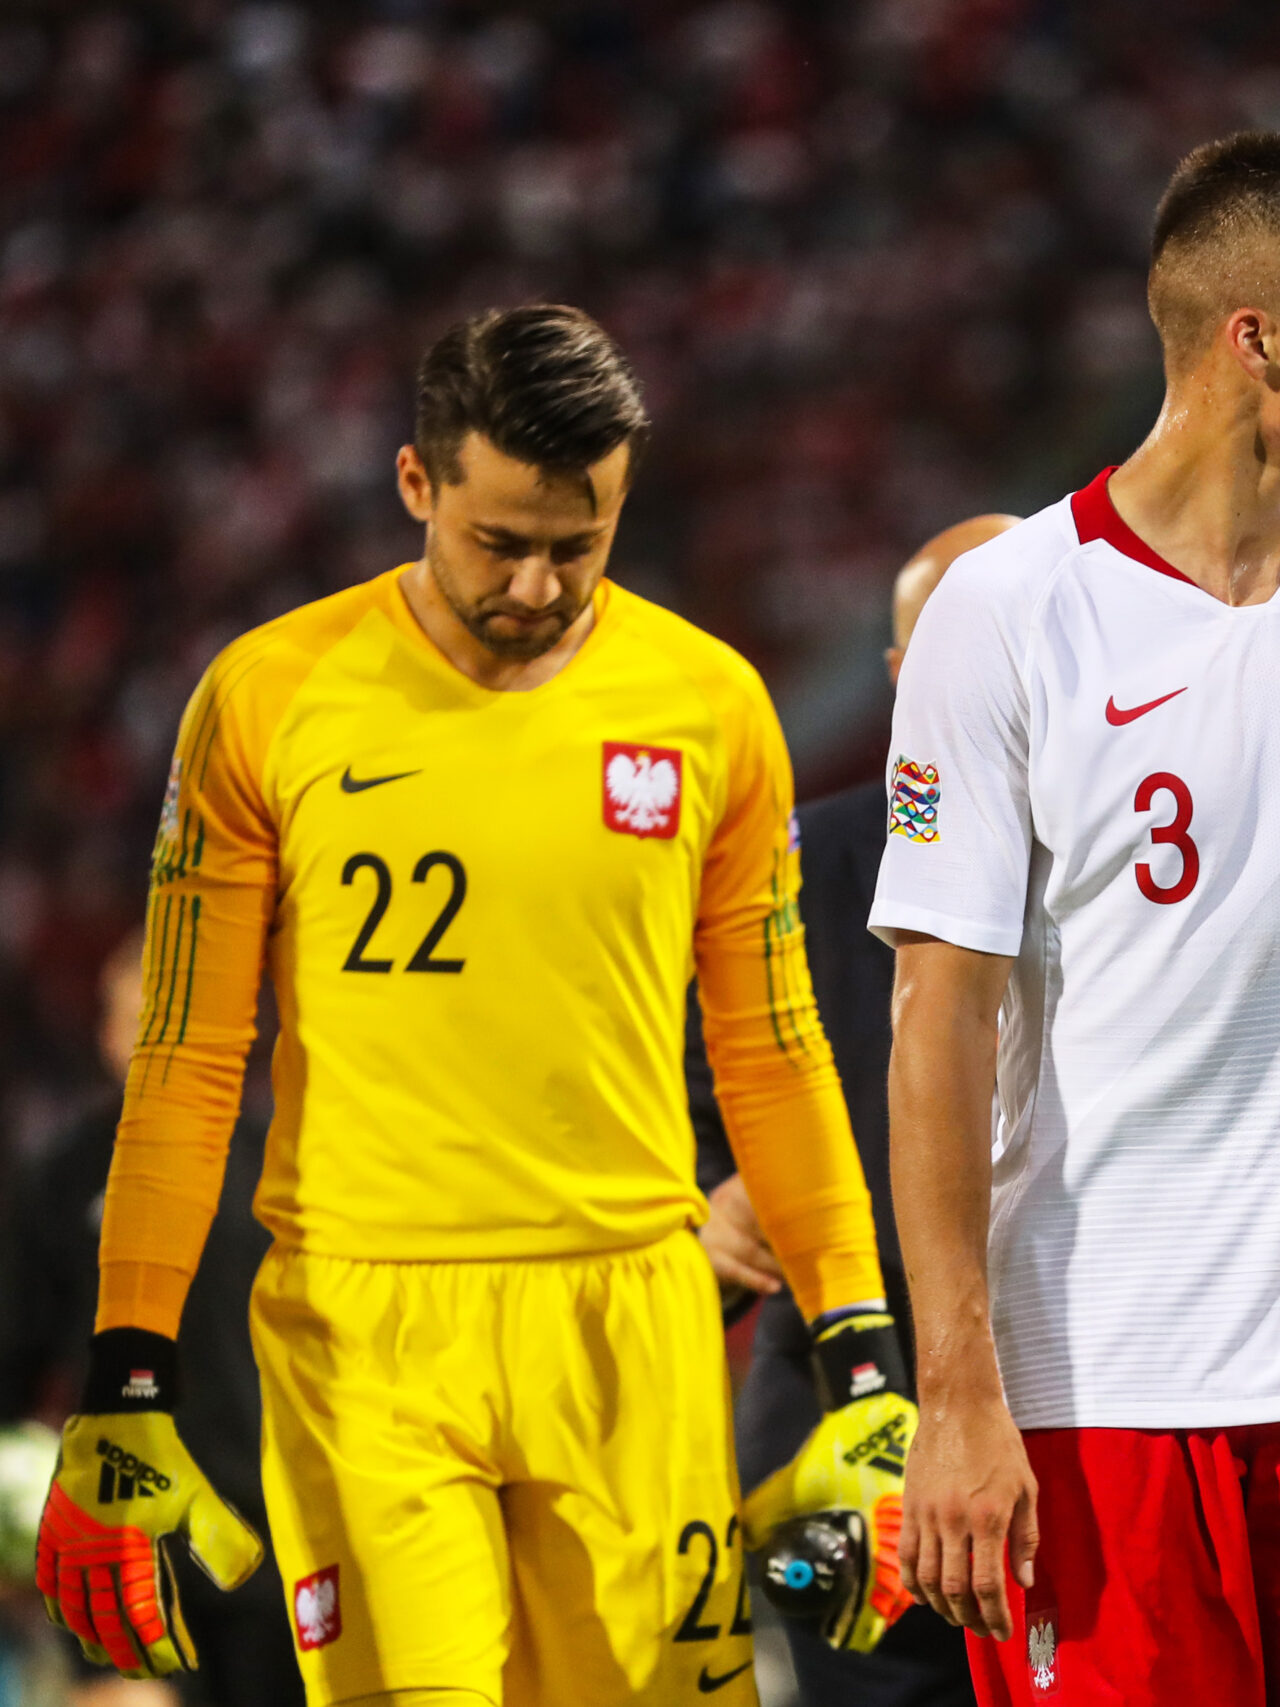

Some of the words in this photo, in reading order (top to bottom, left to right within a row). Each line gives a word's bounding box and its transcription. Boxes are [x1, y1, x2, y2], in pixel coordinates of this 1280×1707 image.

[1134, 772, 1200, 905] 3
[341, 850, 468, 974] 22
[95, 1438, 171, 1492] adidas
